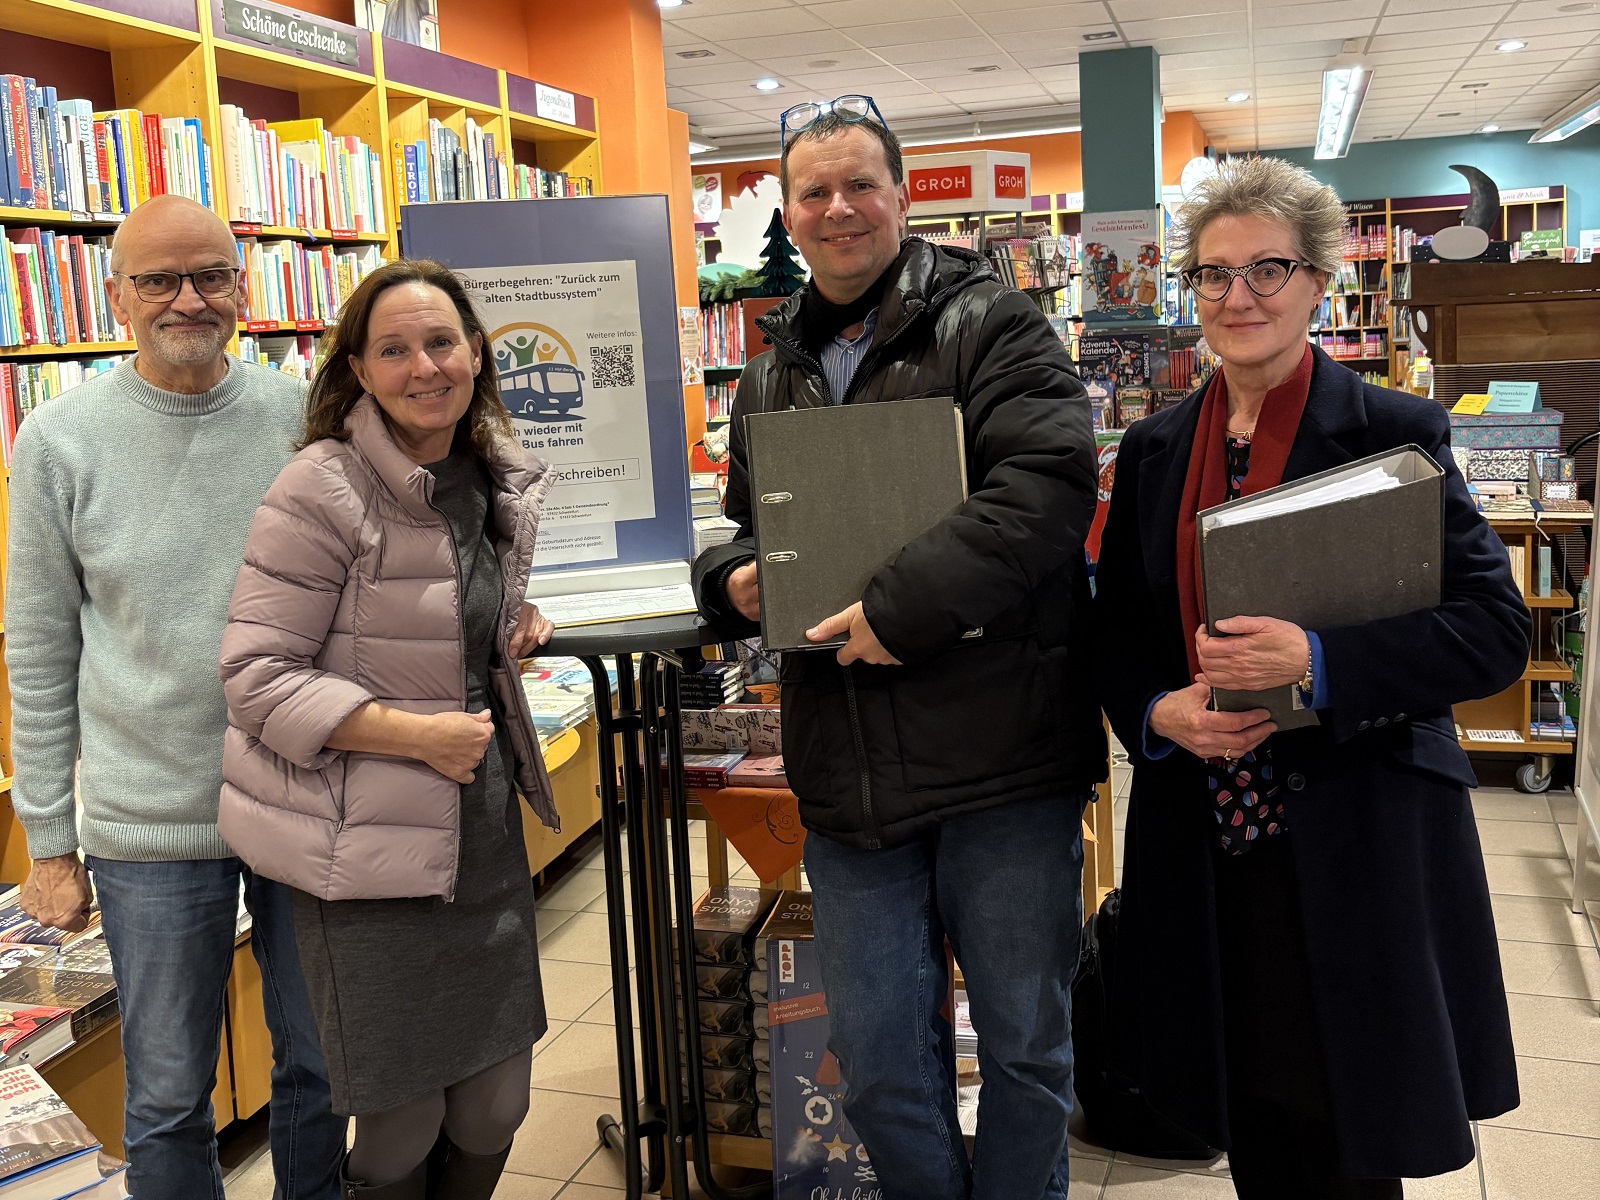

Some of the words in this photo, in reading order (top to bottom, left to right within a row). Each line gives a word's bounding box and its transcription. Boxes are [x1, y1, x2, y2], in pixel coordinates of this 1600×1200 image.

[242, 7, 286, 39] Schöne
[288, 21, 346, 55] Geschenke
[406, 162, 417, 202] TROJ
[916, 176, 966, 191] GROH
[998, 175, 1023, 188] GROH
[1092, 223, 1149, 232] Geschichtenfest!
[464, 276, 553, 290] Bürgerbegehren:
[556, 273, 596, 285] "Zurück
[599, 274, 620, 283] zum
[485, 292, 512, 304] alten
[515, 288, 602, 302] Stadtbussystem"
[586, 331, 616, 340] Weitere
[617, 330, 638, 338] Infos:
[1081, 346, 1118, 356] Kalender
[524, 424, 562, 436] wieder
[564, 422, 583, 433] mit
[522, 438, 544, 450] Bus
[547, 435, 584, 448] fahren
[558, 464, 626, 481] schreiben!
[709, 897, 757, 907] ONYX
[700, 905, 752, 915] STORM
[781, 912, 813, 920] STO
[782, 944, 791, 980] TOPP
[775, 1006, 821, 1020] Anleitungsbuch
[805, 1051, 814, 1059] 22
[3, 1073, 31, 1085] die
